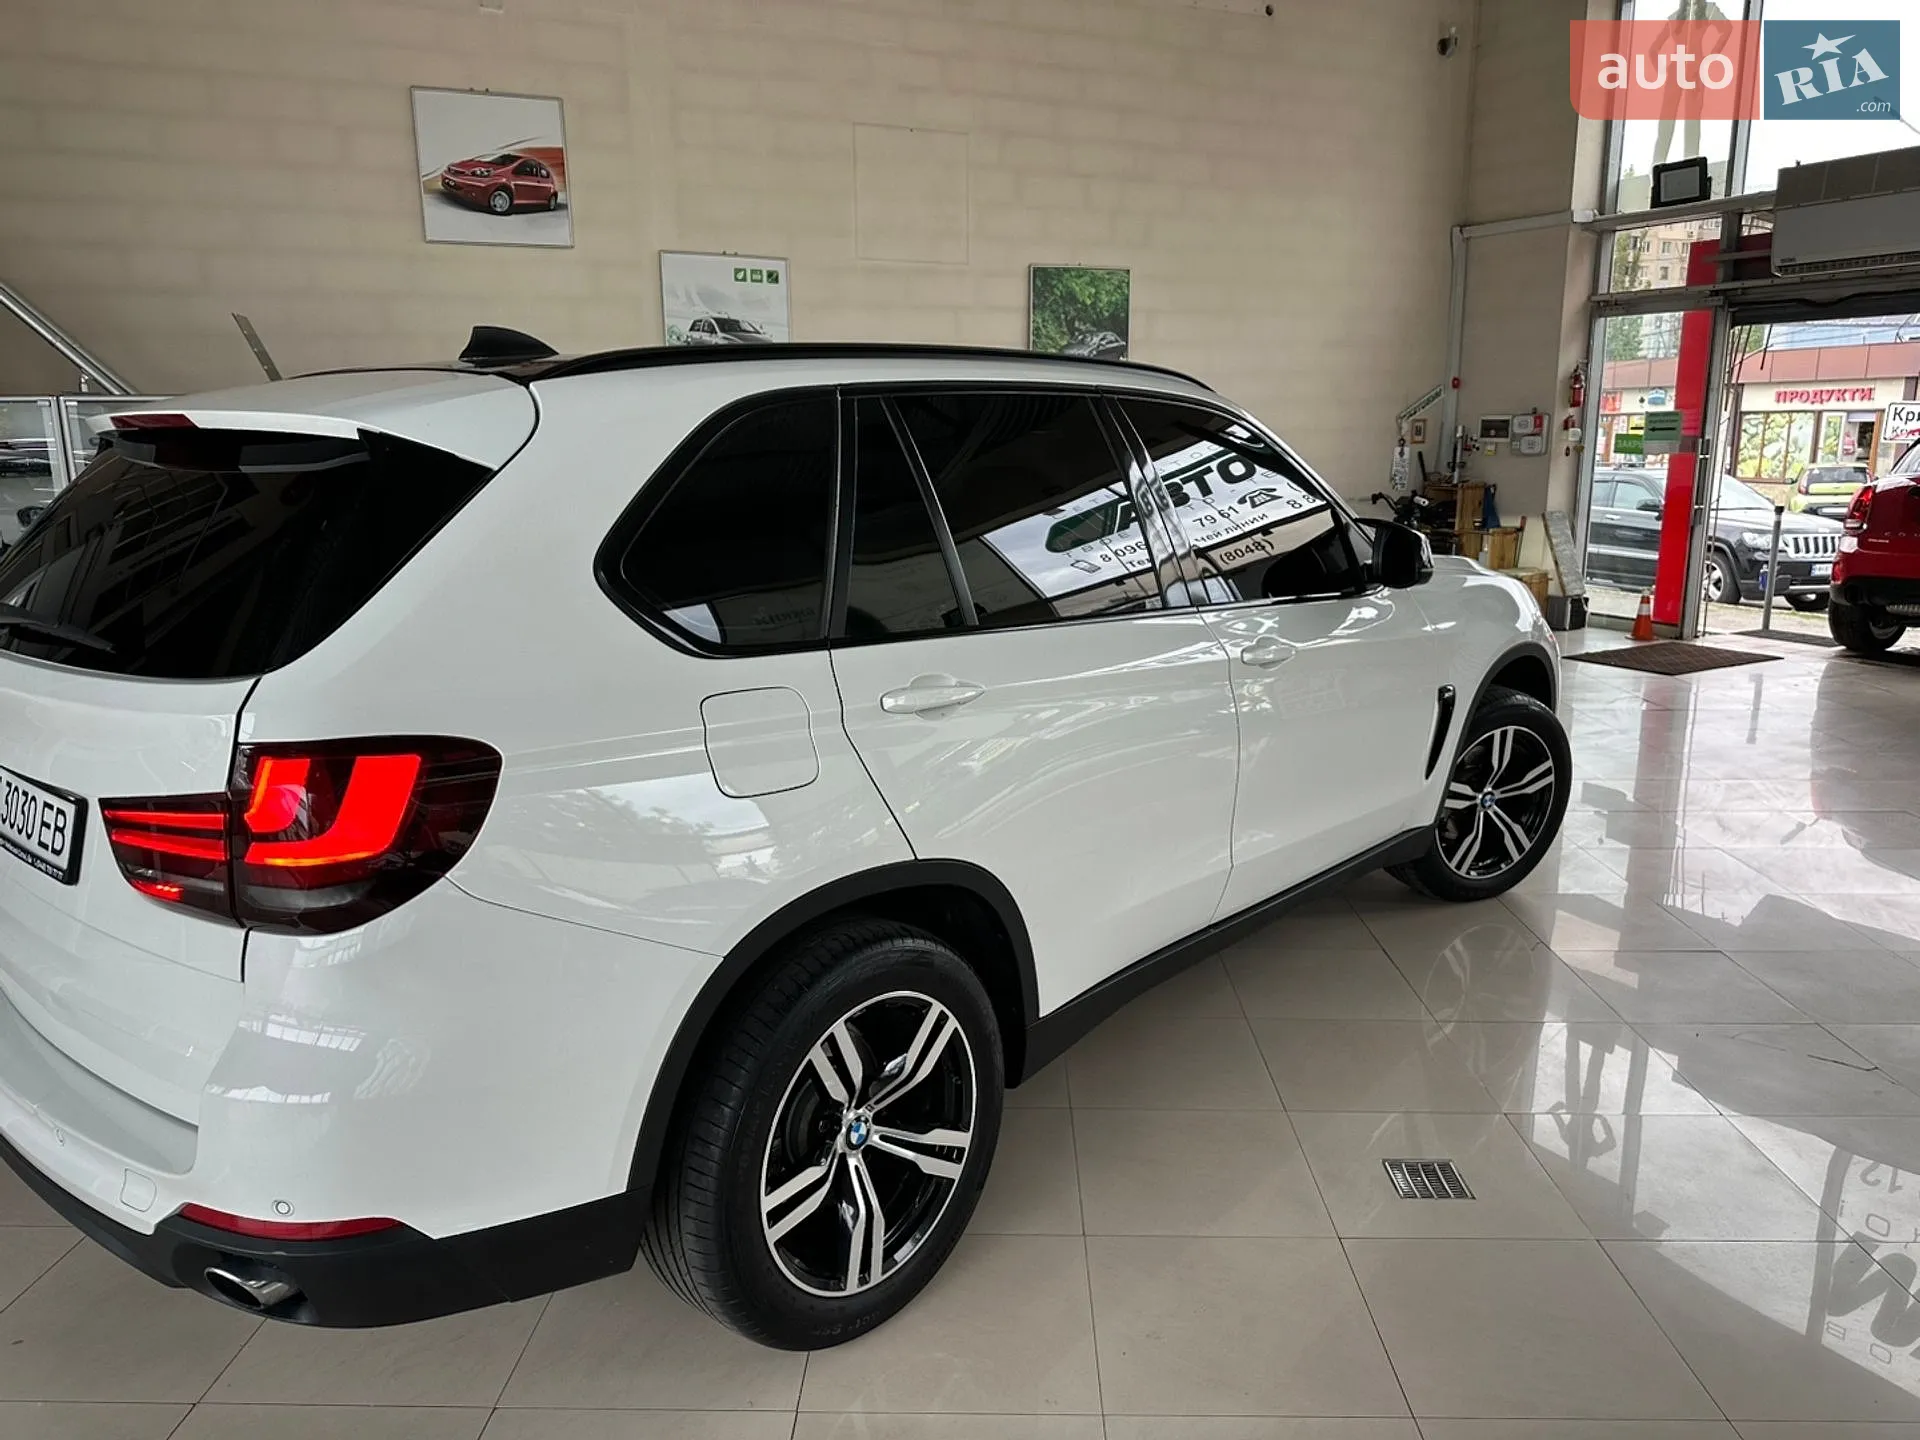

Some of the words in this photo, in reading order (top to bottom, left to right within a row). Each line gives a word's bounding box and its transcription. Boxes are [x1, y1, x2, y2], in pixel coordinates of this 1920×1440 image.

[1775, 387, 1874, 405] ПРОДУКТИ
[1893, 406, 1920, 425] Кр
[1219, 538, 1275, 565] (8048)
[1, 780, 37, 840] 3030
[38, 799, 67, 857] EB
